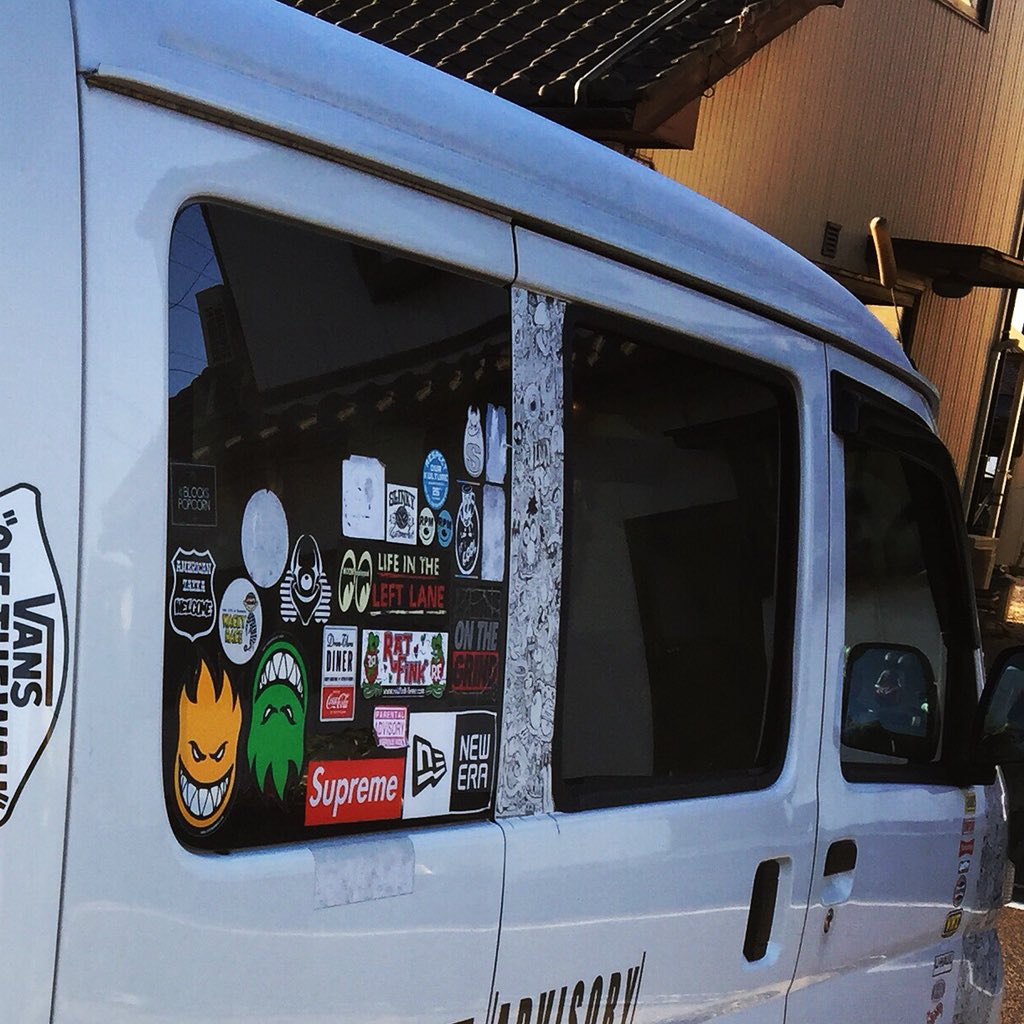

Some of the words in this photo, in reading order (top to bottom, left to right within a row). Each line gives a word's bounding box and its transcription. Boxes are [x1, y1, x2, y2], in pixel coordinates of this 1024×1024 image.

[378, 552, 400, 572] LIFE
[403, 555, 416, 574] IN
[420, 556, 440, 576] THE
[371, 582, 404, 608] LEFT
[408, 583, 446, 609] LANE
[383, 630, 413, 666] RAT
[454, 620, 475, 651] ON
[476, 620, 499, 651] THE
[10, 593, 56, 708] VANS
[326, 650, 353, 672] DINER
[396, 655, 428, 685] FINK
[375, 710, 406, 719] PARENTAL
[459, 733, 491, 762] NEW
[457, 762, 489, 791] ERA
[309, 766, 398, 818] Supreme
